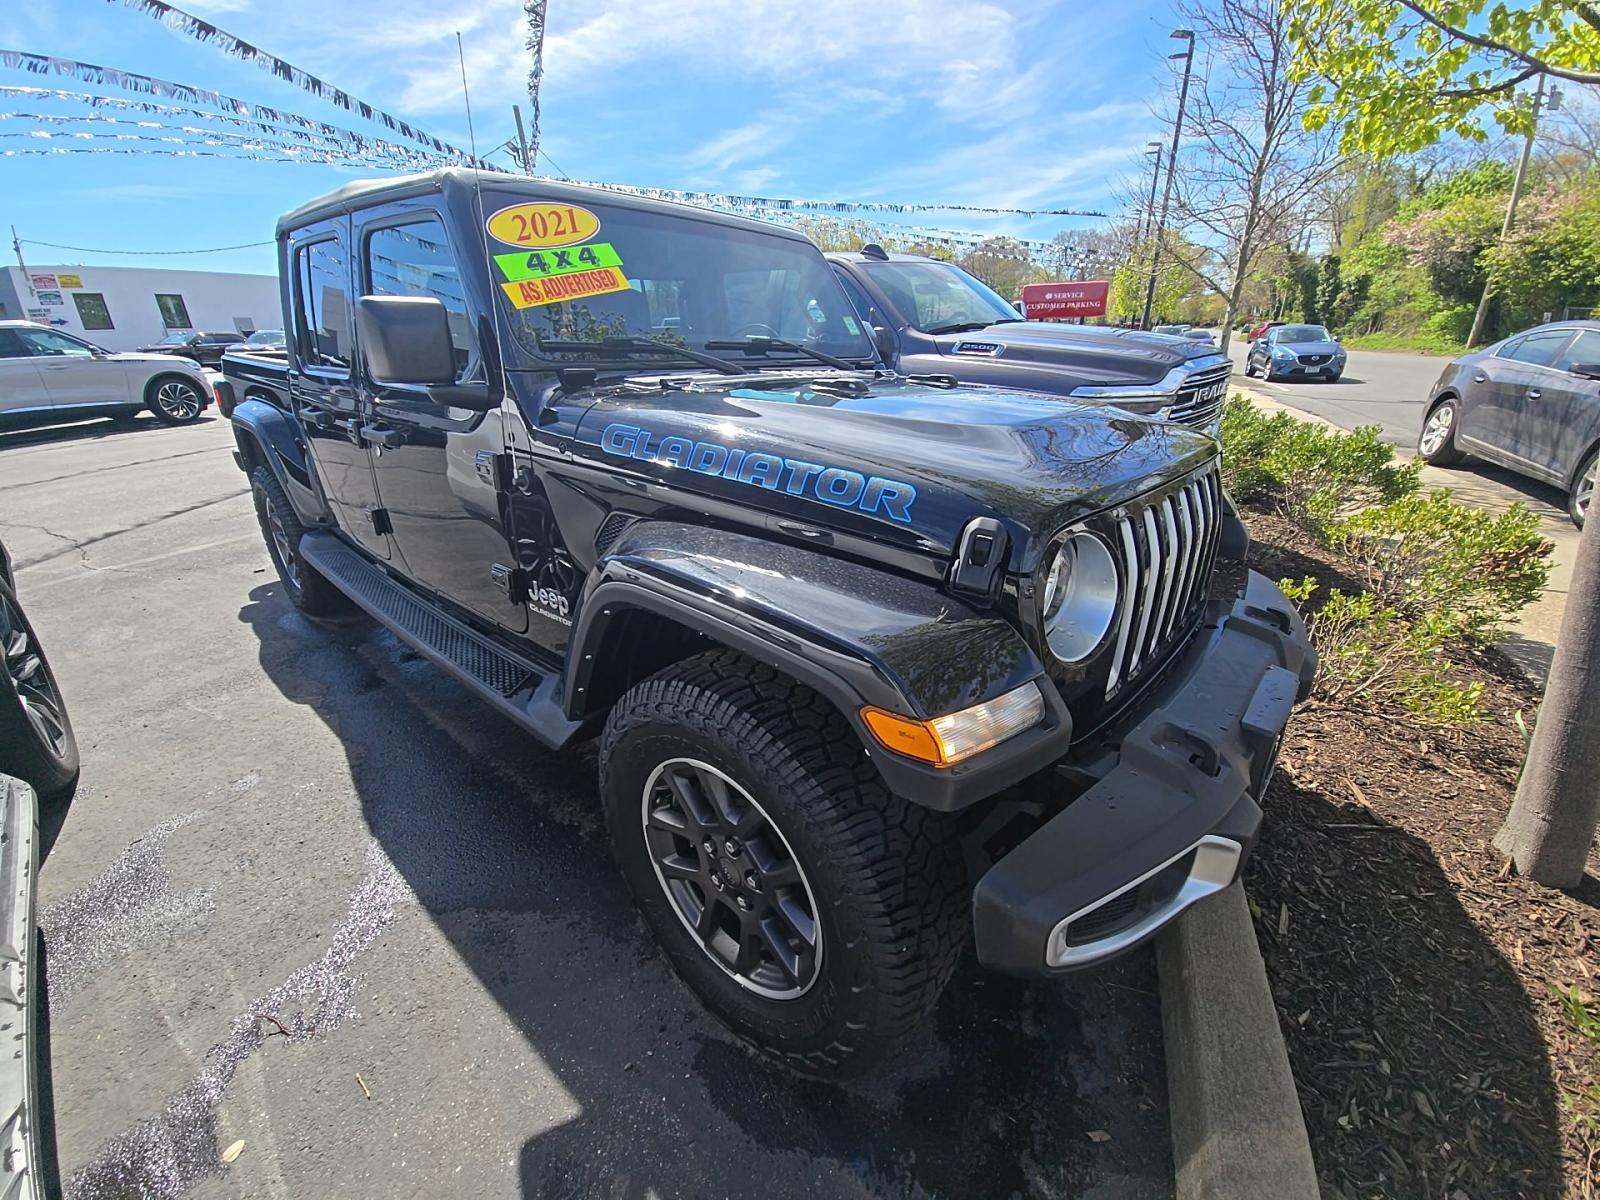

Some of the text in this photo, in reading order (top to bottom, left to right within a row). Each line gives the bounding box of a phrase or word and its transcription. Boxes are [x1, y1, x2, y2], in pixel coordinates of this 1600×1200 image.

[511, 208, 582, 242] 2021
[518, 268, 619, 304] AS ADVERTISED
[1053, 291, 1085, 300] SERVICE
[1026, 300, 1101, 310] CUSTOMER PARKING
[601, 423, 917, 523] GLADIATOR
[528, 580, 569, 617] Jeep
[529, 603, 573, 627] GLADIATOR
